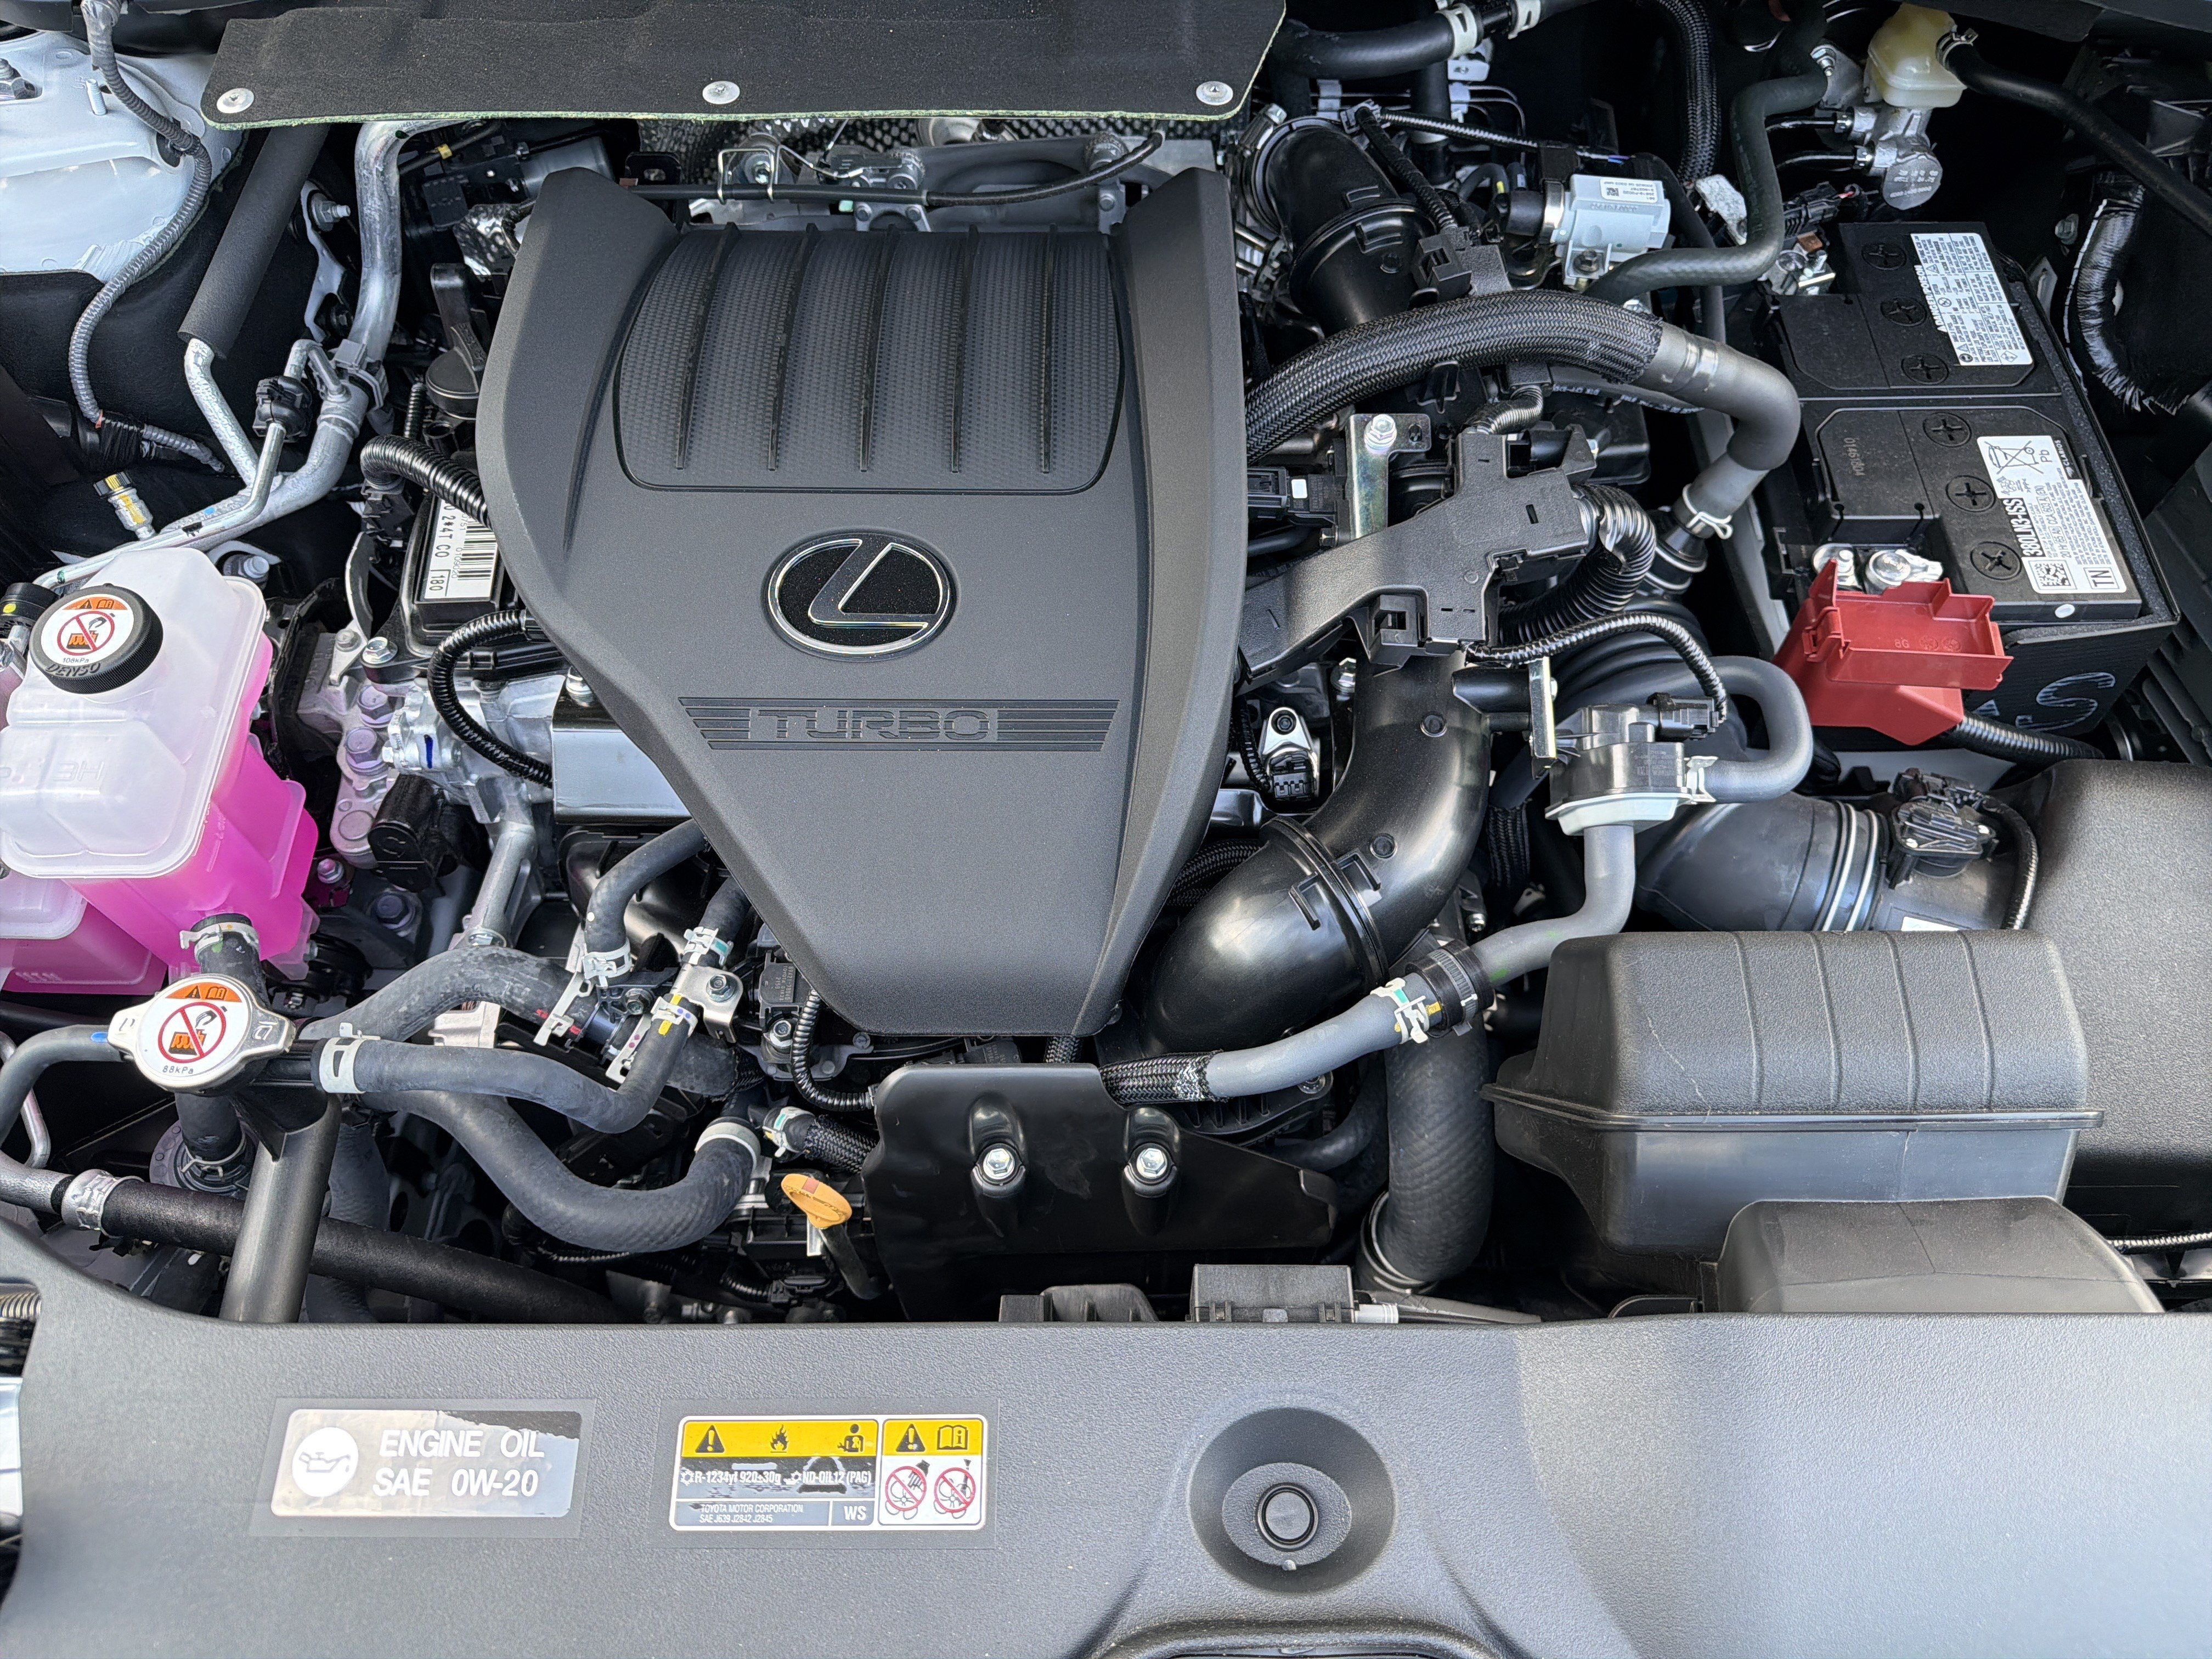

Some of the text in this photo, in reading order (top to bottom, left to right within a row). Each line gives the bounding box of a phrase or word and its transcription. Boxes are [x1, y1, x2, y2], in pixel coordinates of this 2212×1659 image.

[2039, 449, 2053, 462] Pb
[2055, 439, 2070, 467] CLARIOS
[2002, 498, 2043, 557] 380LN3-ISS
[429, 574, 445, 591] 180
[2088, 570, 2114, 588] TN
[46, 662, 101, 677] DENSO
[758, 709, 989, 741] TURBO
[162, 1065, 194, 1075] 88kPa
[379, 1429, 545, 1458] ENGINE OIL
[372, 1468, 539, 1498] SAE 0W-20
[695, 1470, 738, 1486] R-1234yf
[846, 1470, 872, 1486] (PAG)
[702, 1504, 804, 1514] TOYOTA MOTOR CORPORATION
[844, 1505, 866, 1521] WS
[699, 1514, 713, 1523] SAE
[714, 1514, 731, 1523] J639
